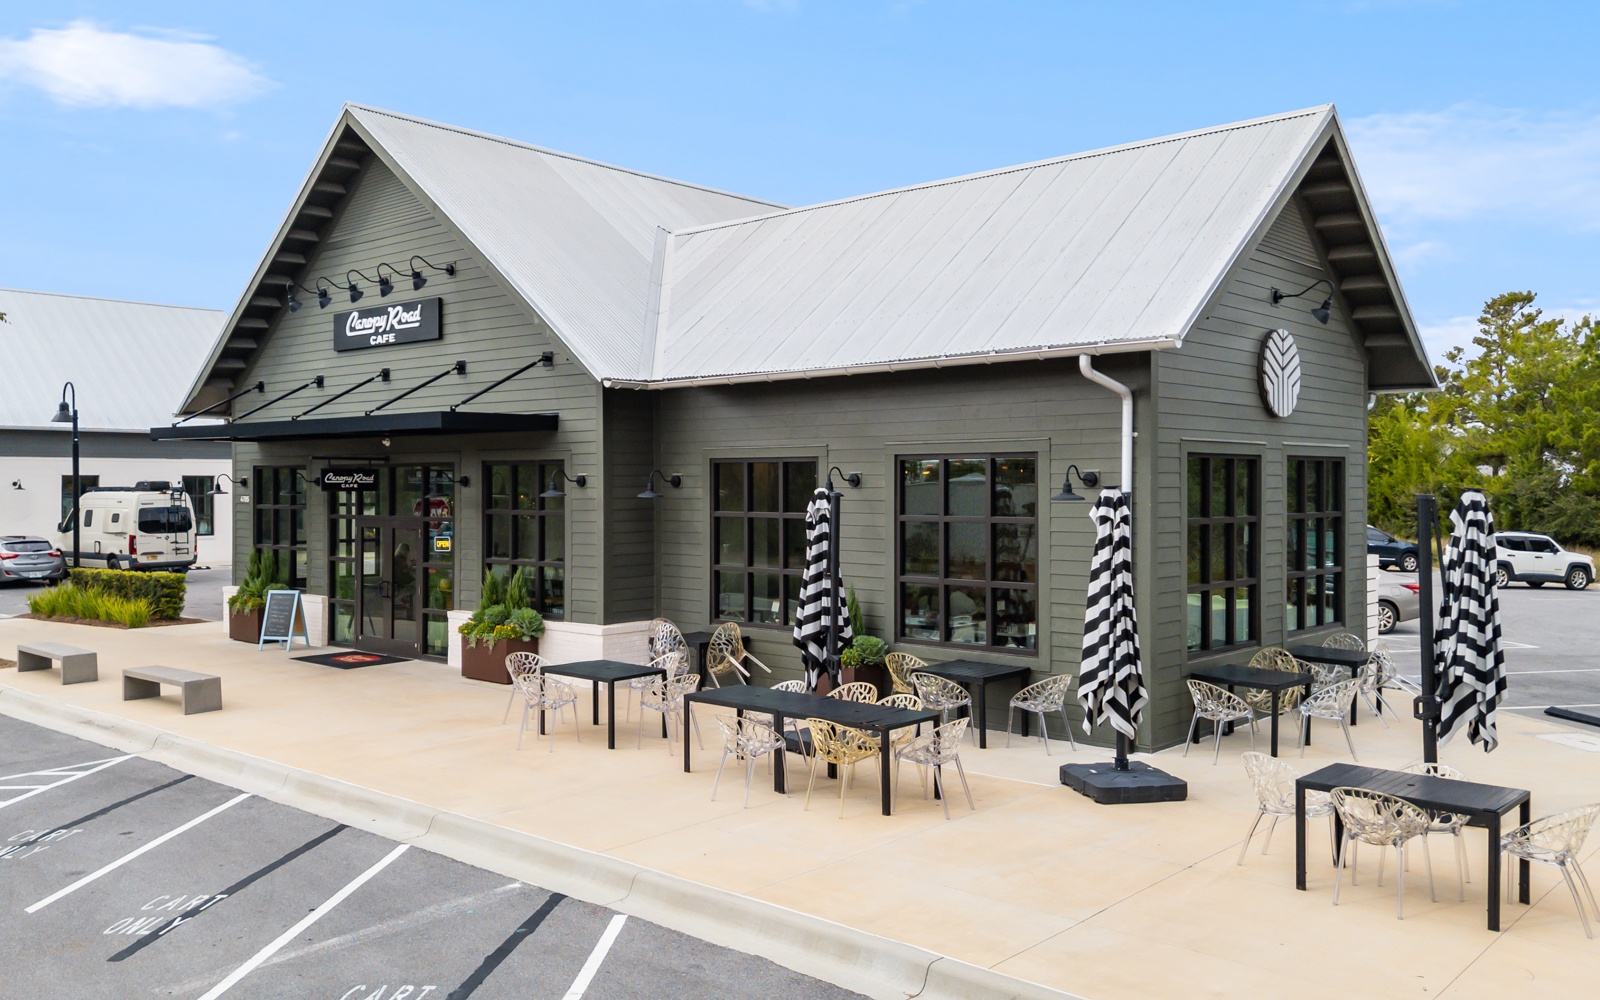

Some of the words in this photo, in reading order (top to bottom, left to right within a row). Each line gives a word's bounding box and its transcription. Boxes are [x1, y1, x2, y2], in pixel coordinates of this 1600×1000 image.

[346, 311, 388, 336] Canopy
[386, 304, 422, 331] Road
[370, 333, 396, 345] CAFE
[325, 472, 353, 483] Canopy
[352, 473, 375, 483] Road
[436, 540, 451, 548] OPEN
[8, 829, 83, 842] CART
[0, 845, 51, 859] NLY
[141, 894, 228, 910] CART
[103, 916, 193, 935] ONLY
[340, 984, 437, 1000] CART
